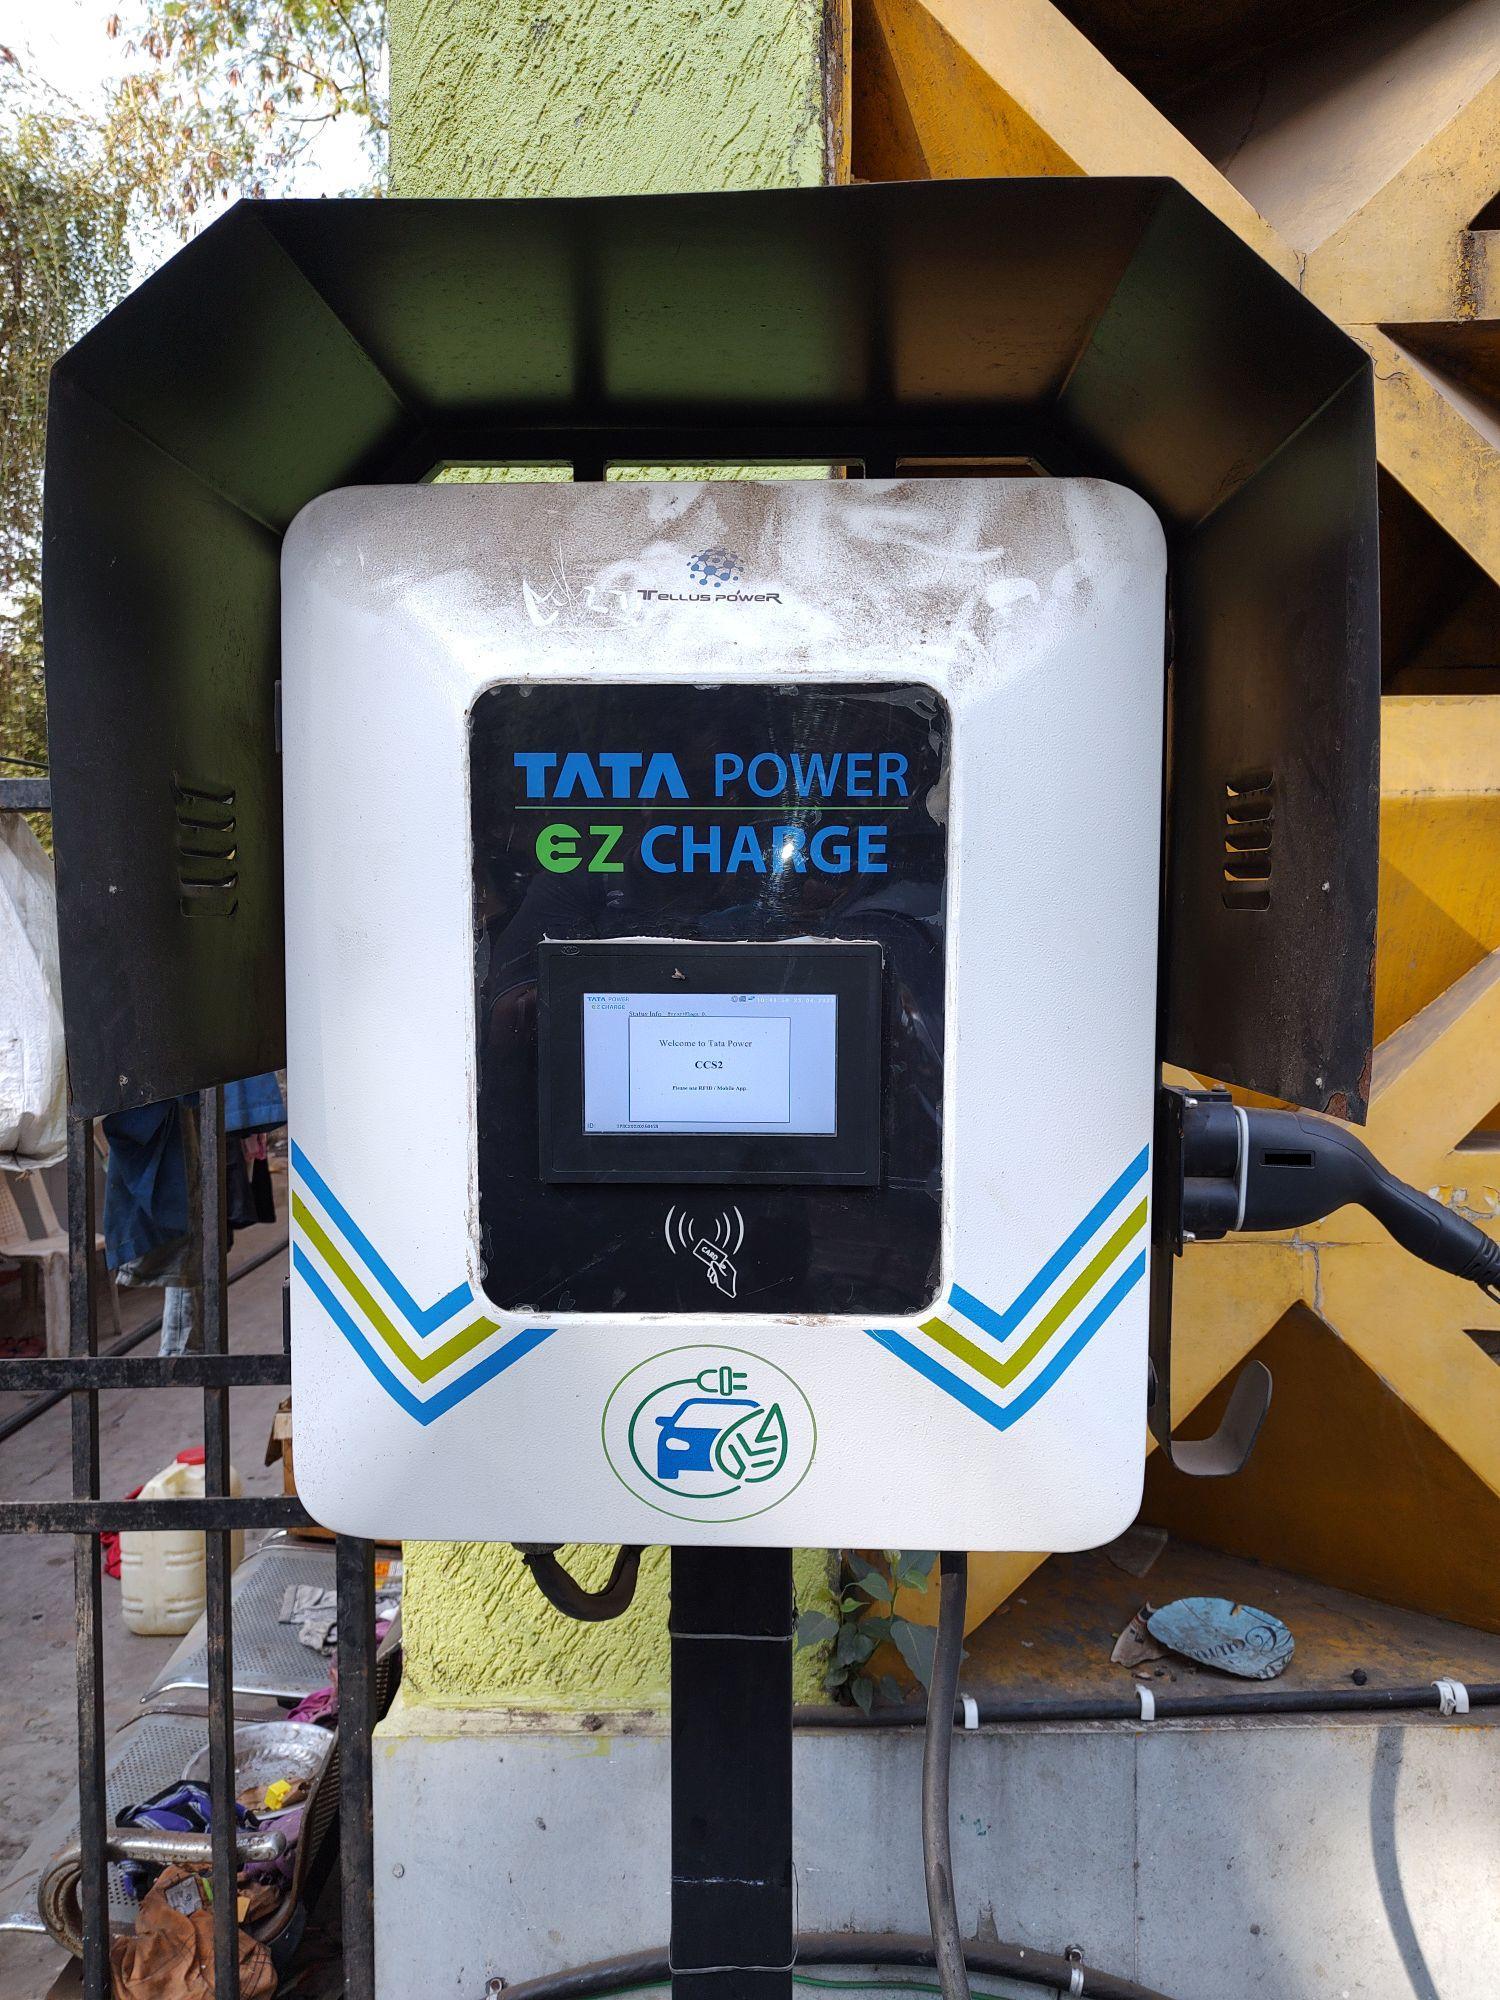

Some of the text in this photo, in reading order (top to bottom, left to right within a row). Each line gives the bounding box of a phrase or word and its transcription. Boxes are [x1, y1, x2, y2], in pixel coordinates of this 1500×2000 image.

[513, 752, 909, 798] TATA POWER
[640, 824, 888, 873] CHARGE
[659, 1039, 753, 1048] Welcome to Tata Power
[695, 1060, 723, 1070] CCS2
